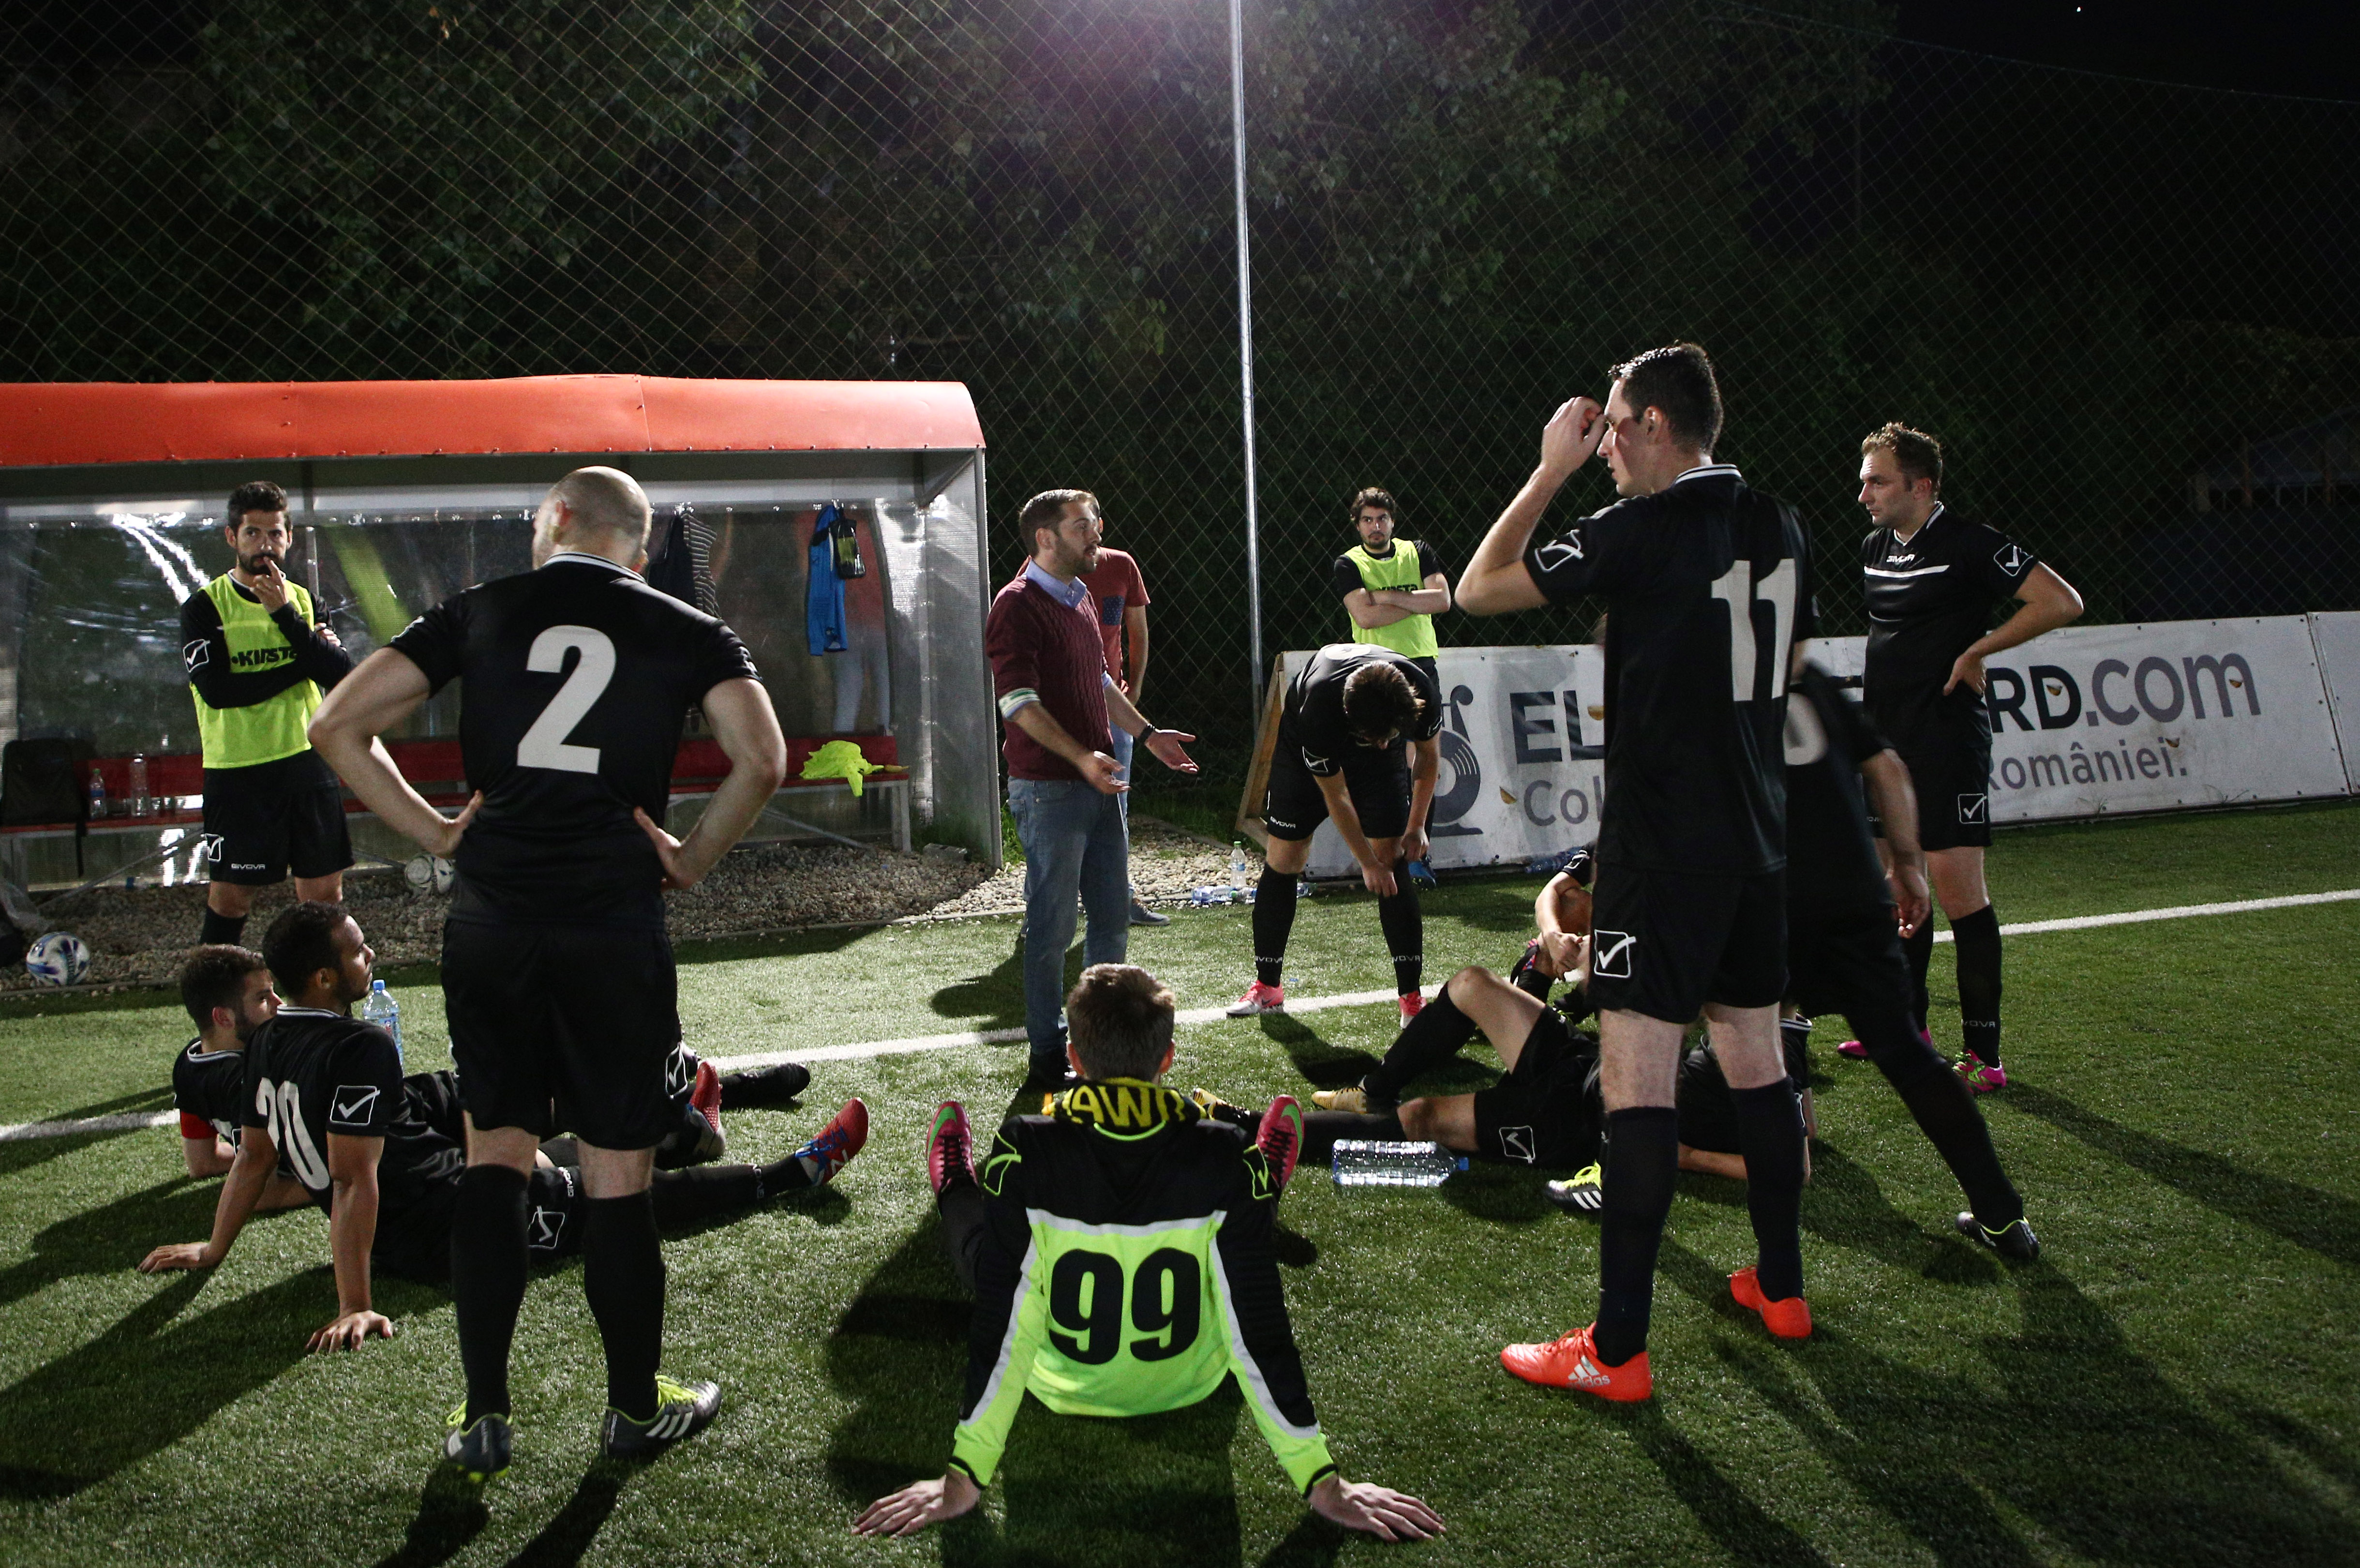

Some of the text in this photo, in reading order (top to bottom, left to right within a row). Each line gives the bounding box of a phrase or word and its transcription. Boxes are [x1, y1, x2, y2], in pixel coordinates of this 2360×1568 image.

[517, 624, 616, 774] 2
[1711, 558, 1795, 701] 11
[1049, 1247, 1201, 1365] 99
